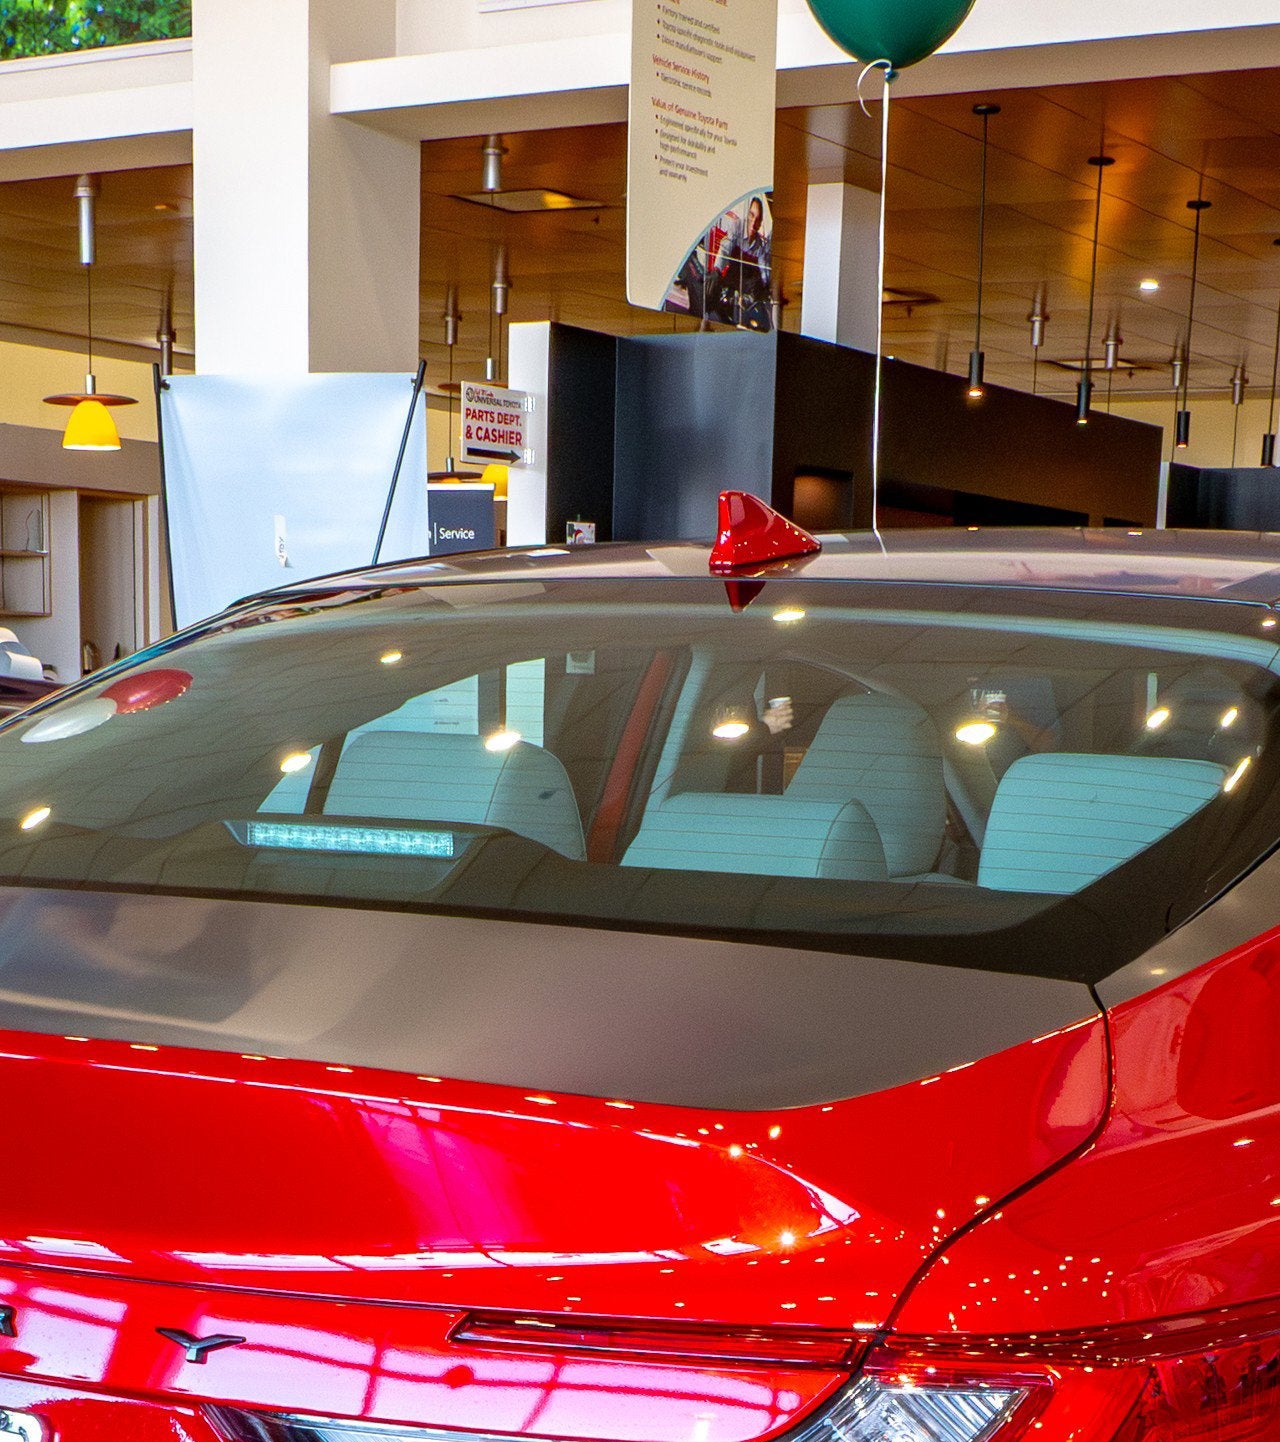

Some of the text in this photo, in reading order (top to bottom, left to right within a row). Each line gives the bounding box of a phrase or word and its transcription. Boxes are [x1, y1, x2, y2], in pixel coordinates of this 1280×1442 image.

[474, 396, 502, 407] UNIVERSAL
[465, 407, 522, 427] PARTS DEPT.
[465, 425, 522, 446] & CASHIER
[439, 527, 475, 540] Service
